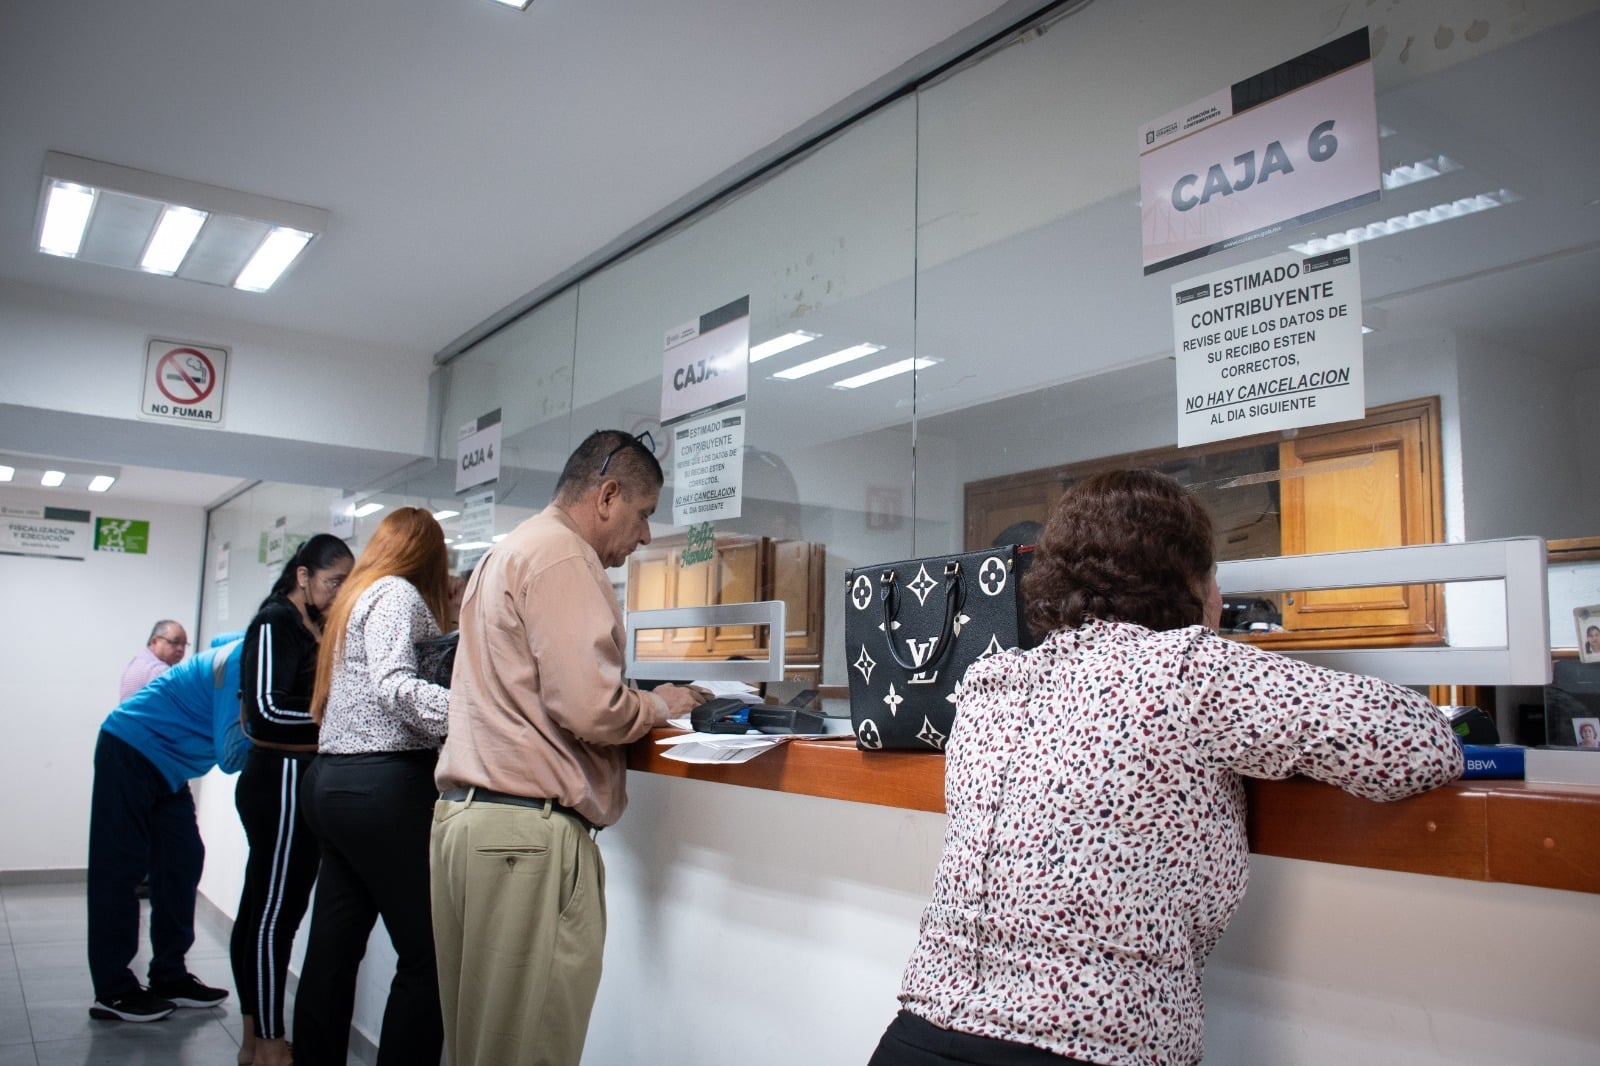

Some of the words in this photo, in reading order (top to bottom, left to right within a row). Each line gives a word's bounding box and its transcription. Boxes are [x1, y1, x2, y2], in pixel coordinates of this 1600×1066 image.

[1171, 140, 1294, 212] CAJA
[1307, 120, 1338, 163] 6
[1213, 263, 1299, 298] ESTIMADO
[1191, 281, 1334, 329] CONTRIBUYENTE
[1183, 332, 1221, 352] REVISE
[1224, 326, 1248, 342] QUE
[1252, 319, 1276, 335] LOS
[1279, 309, 1325, 329] DATOS
[1329, 304, 1347, 319] DE
[1207, 350, 1222, 364] SU
[1226, 340, 1270, 360] RECIBO
[1274, 330, 1316, 349] ESTEN
[1221, 353, 1300, 379] CORRECTOS,
[1185, 395, 1203, 411] NO
[1207, 388, 1234, 407] HAY
[1237, 367, 1350, 400] CANCELACION
[151, 403, 169, 414] NO
[172, 406, 213, 419] FUMAR
[1210, 411, 1224, 425] AL
[1227, 407, 1246, 422] DIA
[1249, 396, 1316, 418] SIGUIENTE
[689, 421, 721, 439] ESTIMADO
[462, 447, 485, 471] CAJA
[487, 443, 494, 460] 4
[681, 434, 733, 456] CONTRIBUYENTE
[729, 448, 737, 457] DE
[709, 463, 725, 473] ESTEN
[694, 486, 737, 502] CANCELACION
[1467, 760, 1497, 770] BBVA
